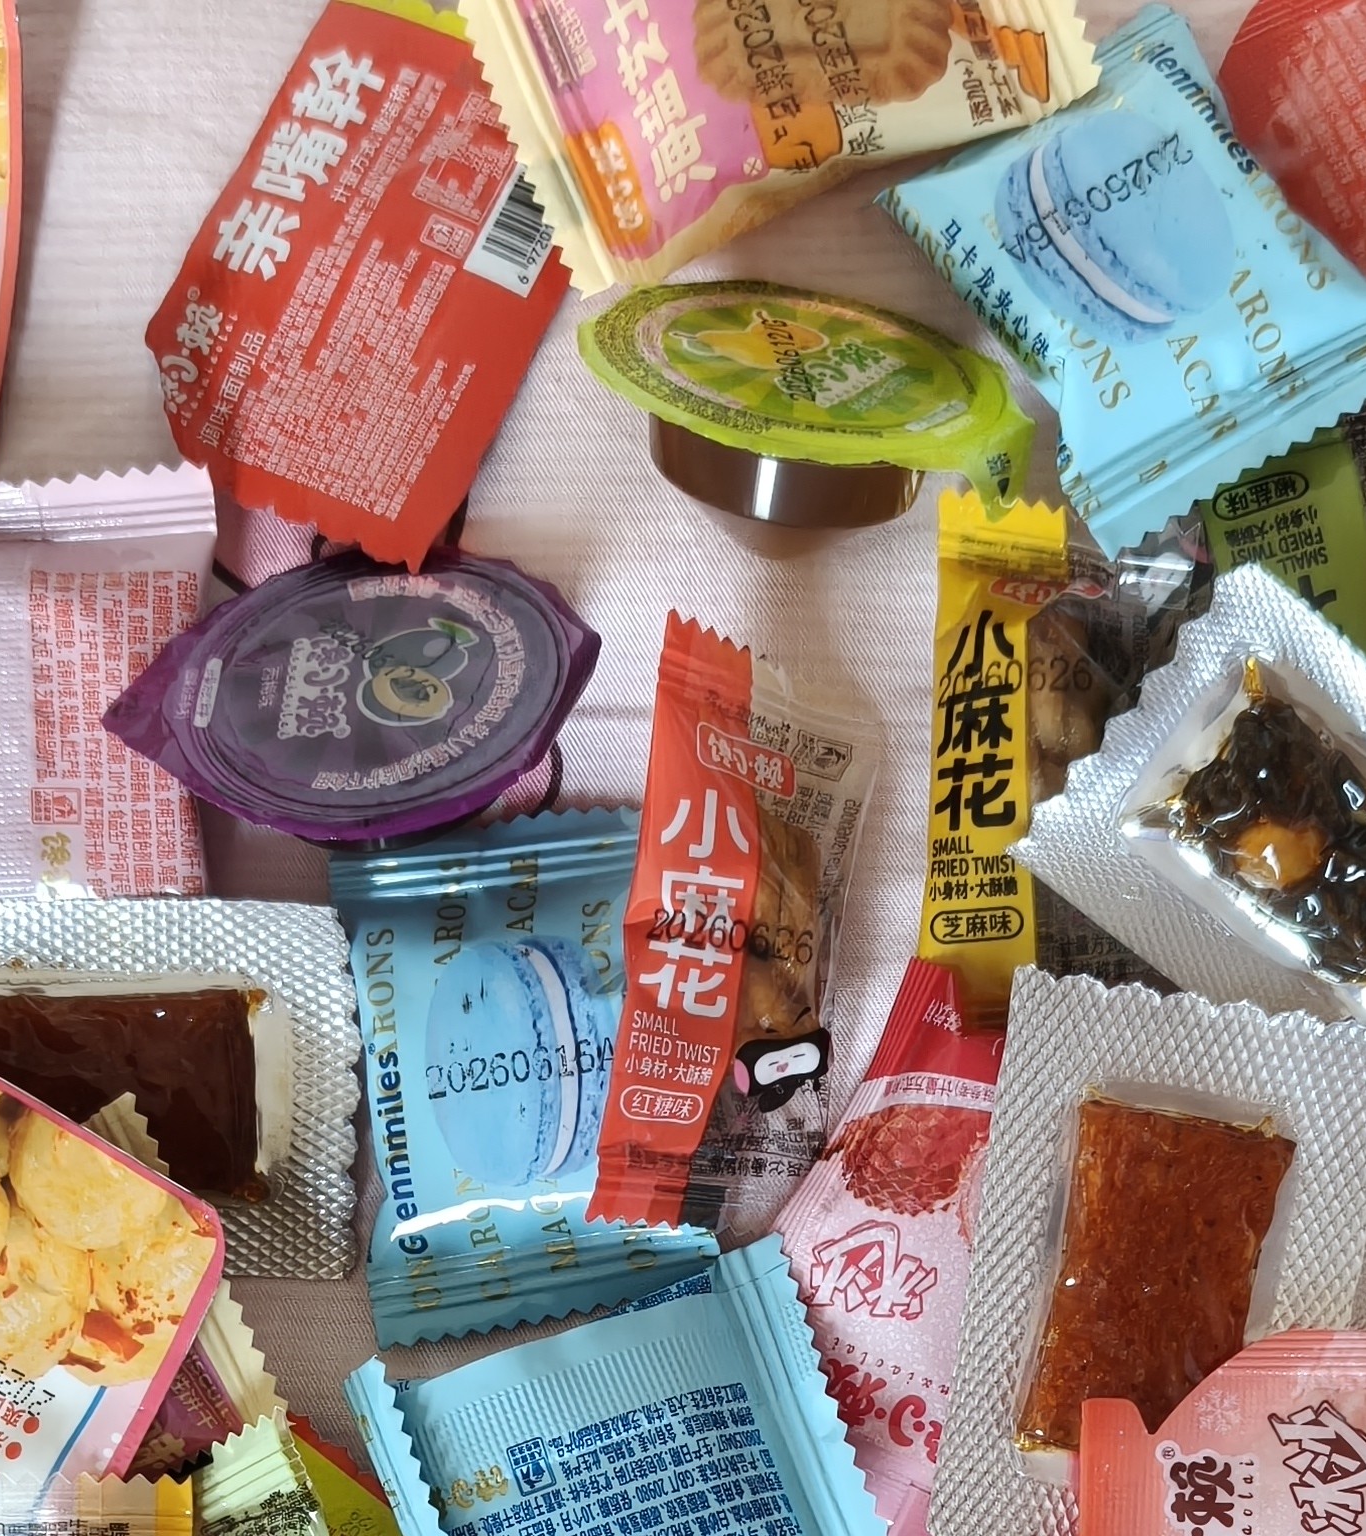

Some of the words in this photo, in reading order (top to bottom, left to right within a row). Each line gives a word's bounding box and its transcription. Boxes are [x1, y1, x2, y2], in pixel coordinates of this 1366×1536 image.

[195, 325, 268, 450] 调味面制品
[1223, 473, 1297, 515] 椒盐味
[1277, 525, 1324, 552] FRIED
[1276, 545, 1327, 572] SMALL
[934, 607, 1019, 833] 小麻花
[931, 837, 975, 861] SMALL
[930, 857, 970, 879] FRIED
[970, 855, 1016, 877] TWIST
[637, 782, 756, 1020] 小麻花
[941, 915, 1011, 936] 芝麻味
[631, 1009, 681, 1036] SMALL
[628, 1031, 673, 1057] FRIED
[672, 1040, 721, 1067] TWIST
[630, 1091, 694, 1121] 红糖味
